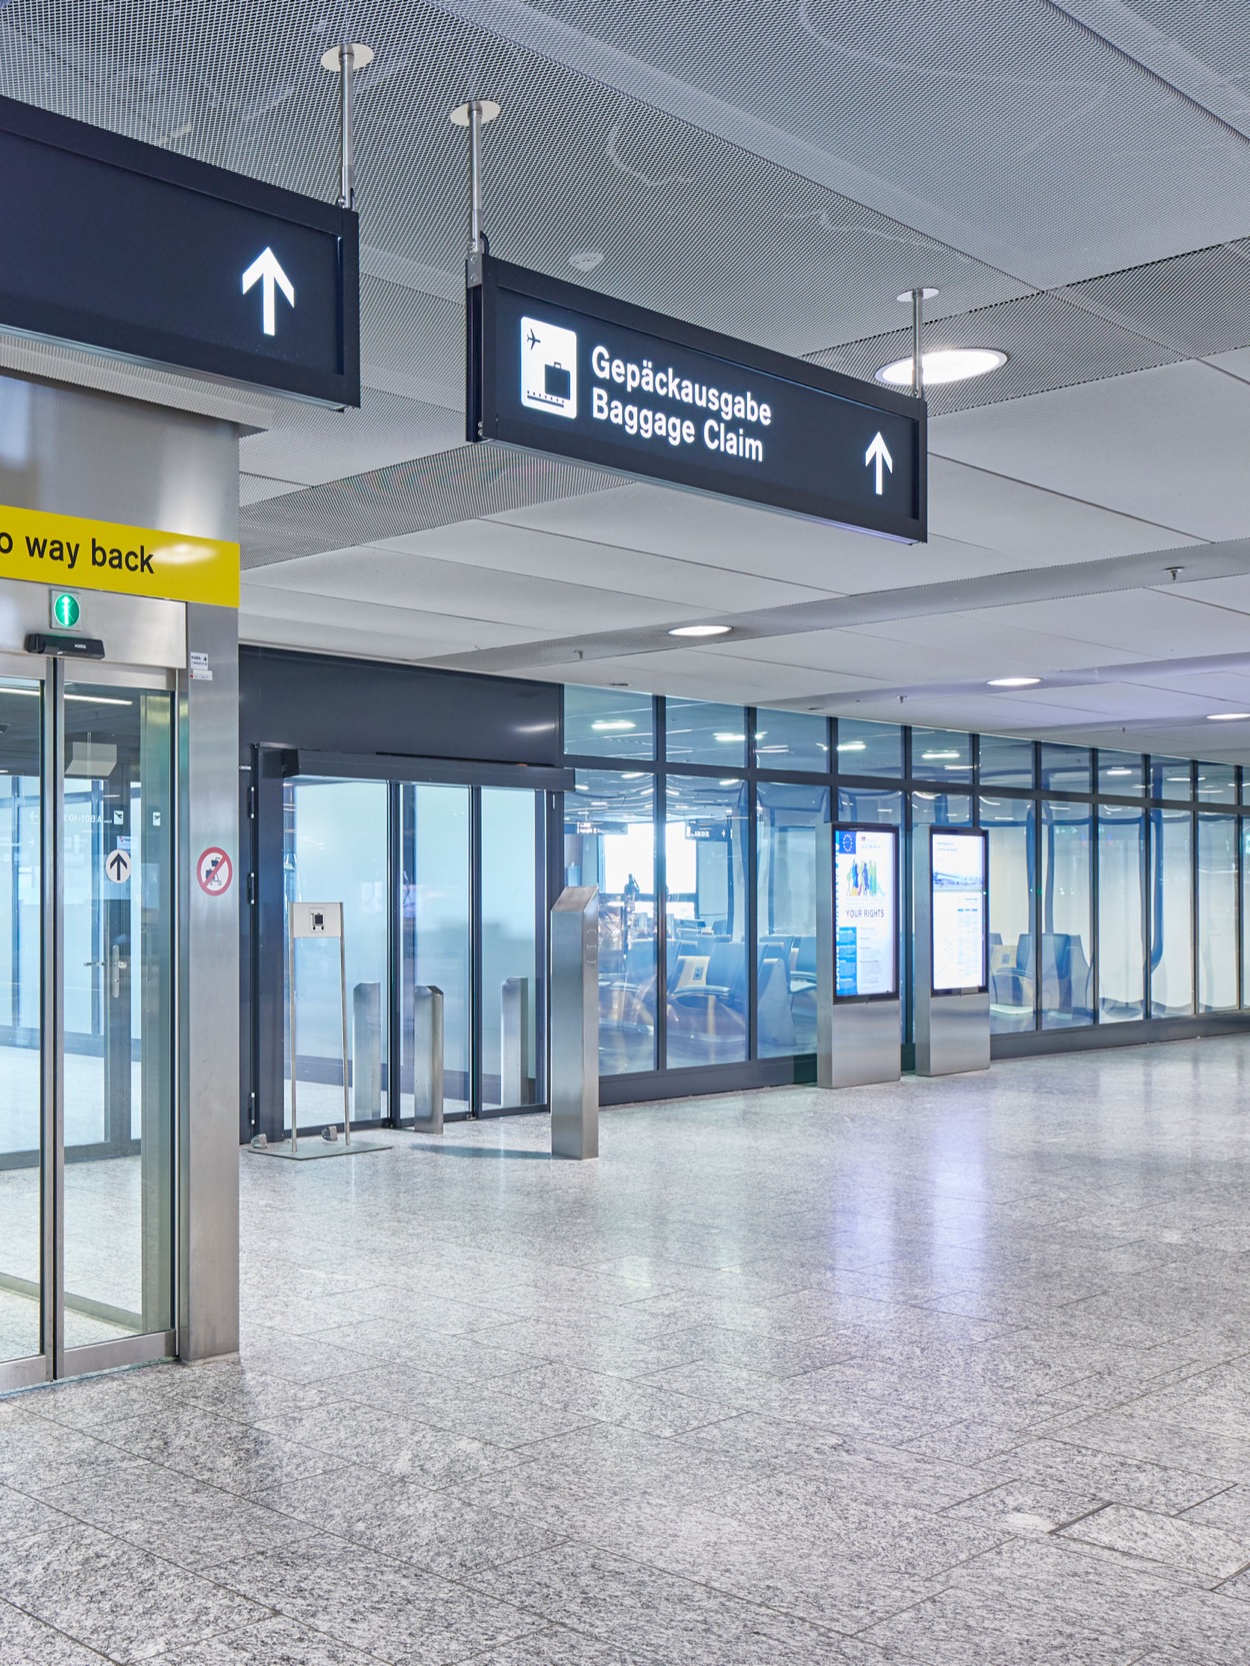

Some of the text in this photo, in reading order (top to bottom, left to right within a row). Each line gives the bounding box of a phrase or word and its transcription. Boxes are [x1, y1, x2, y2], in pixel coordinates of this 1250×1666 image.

[591, 345, 772, 426] Gepäckausgabe
[592, 386, 763, 463] Baggage Claim
[24, 535, 80, 569] way
[91, 537, 155, 574] back
[845, 909, 885, 919] YOUR RIGHTS
